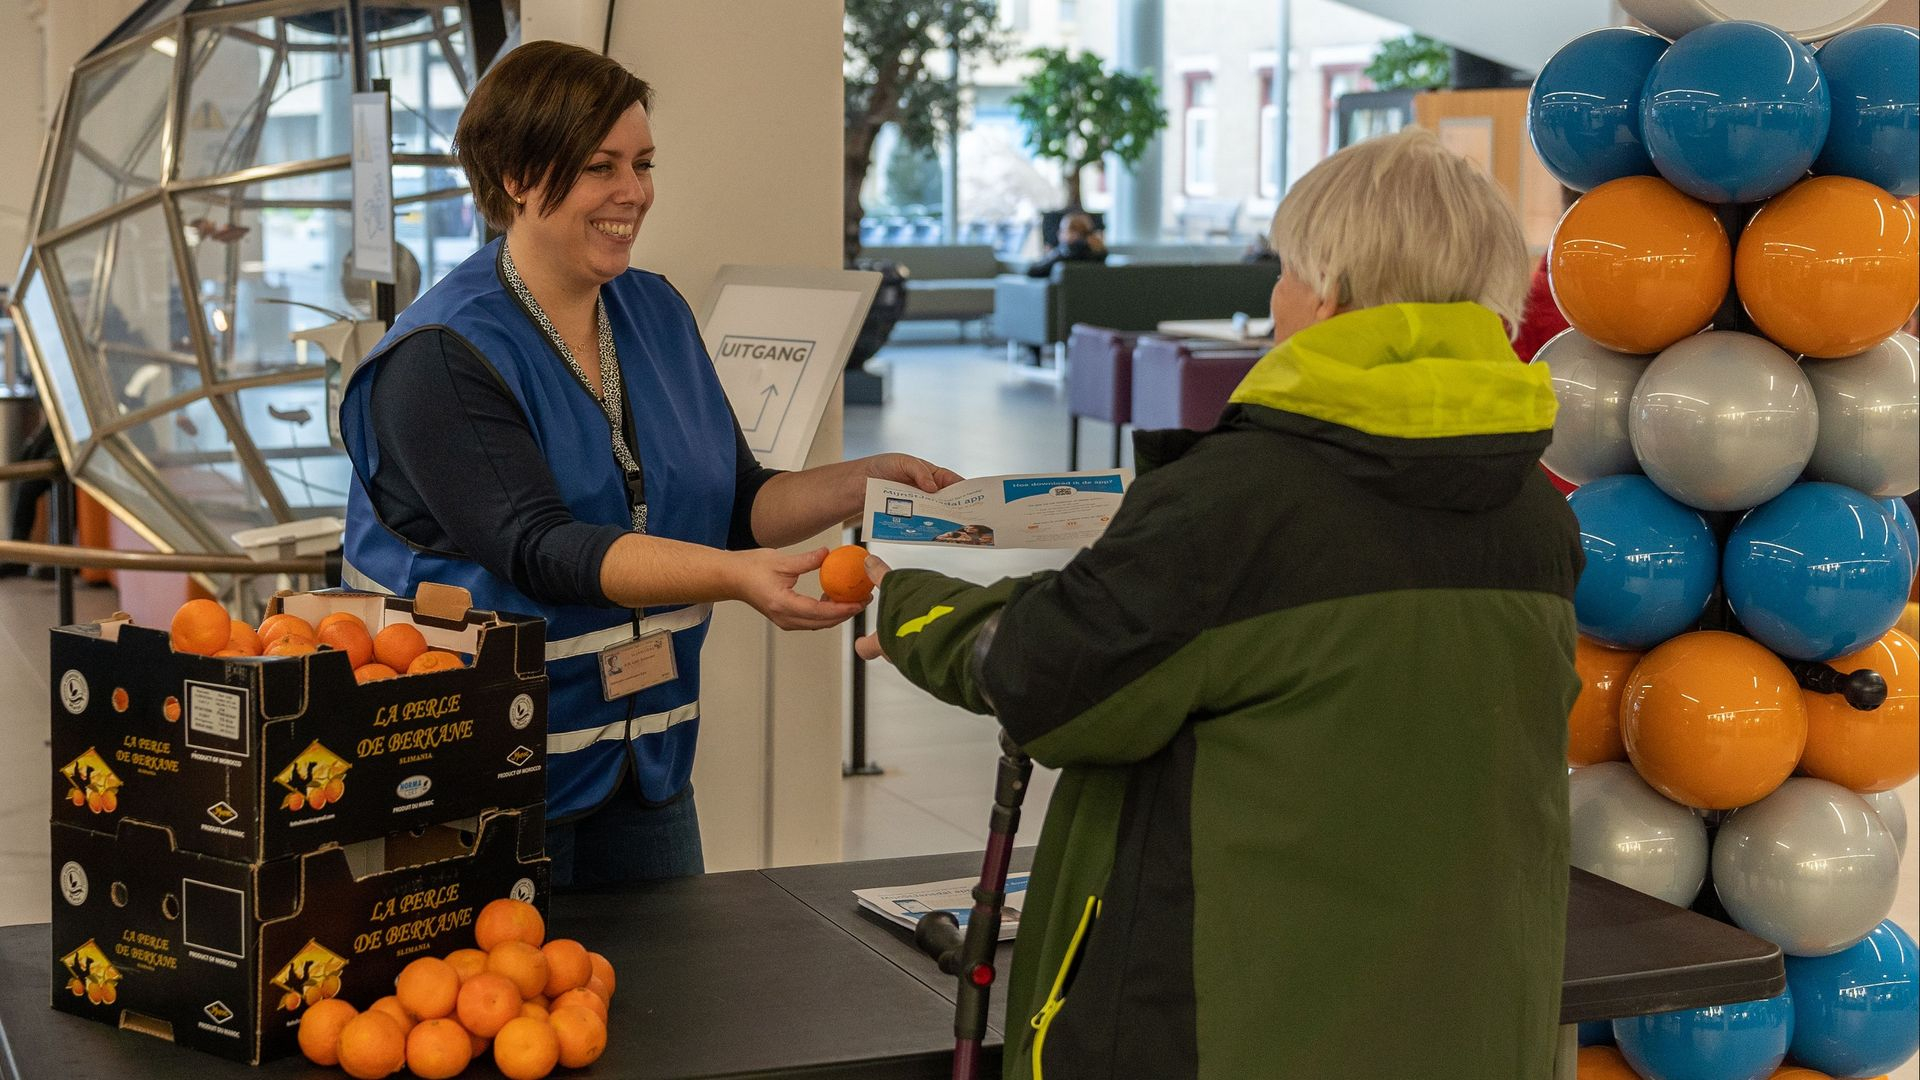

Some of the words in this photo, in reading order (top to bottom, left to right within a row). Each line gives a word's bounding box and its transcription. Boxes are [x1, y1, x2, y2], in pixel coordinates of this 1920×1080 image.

[721, 342, 808, 362] UITGANG
[964, 493, 985, 505] app
[373, 704, 399, 727] LA
[402, 694, 461, 721] PERLE
[123, 735, 137, 748] LA
[138, 738, 171, 754] PERLE
[357, 736, 385, 758] DE
[388, 720, 474, 753] BERKANE
[116, 750, 131, 763] DE
[131, 753, 180, 773] BERKANE
[370, 897, 396, 921] LA
[400, 883, 460, 914] PERLE
[123, 930, 135, 942] LA
[137, 933, 169, 950] PERLE
[353, 930, 382, 954] DE
[385, 907, 473, 946] BERKANE
[115, 944, 129, 956] DE
[131, 948, 177, 969] BERKANE
